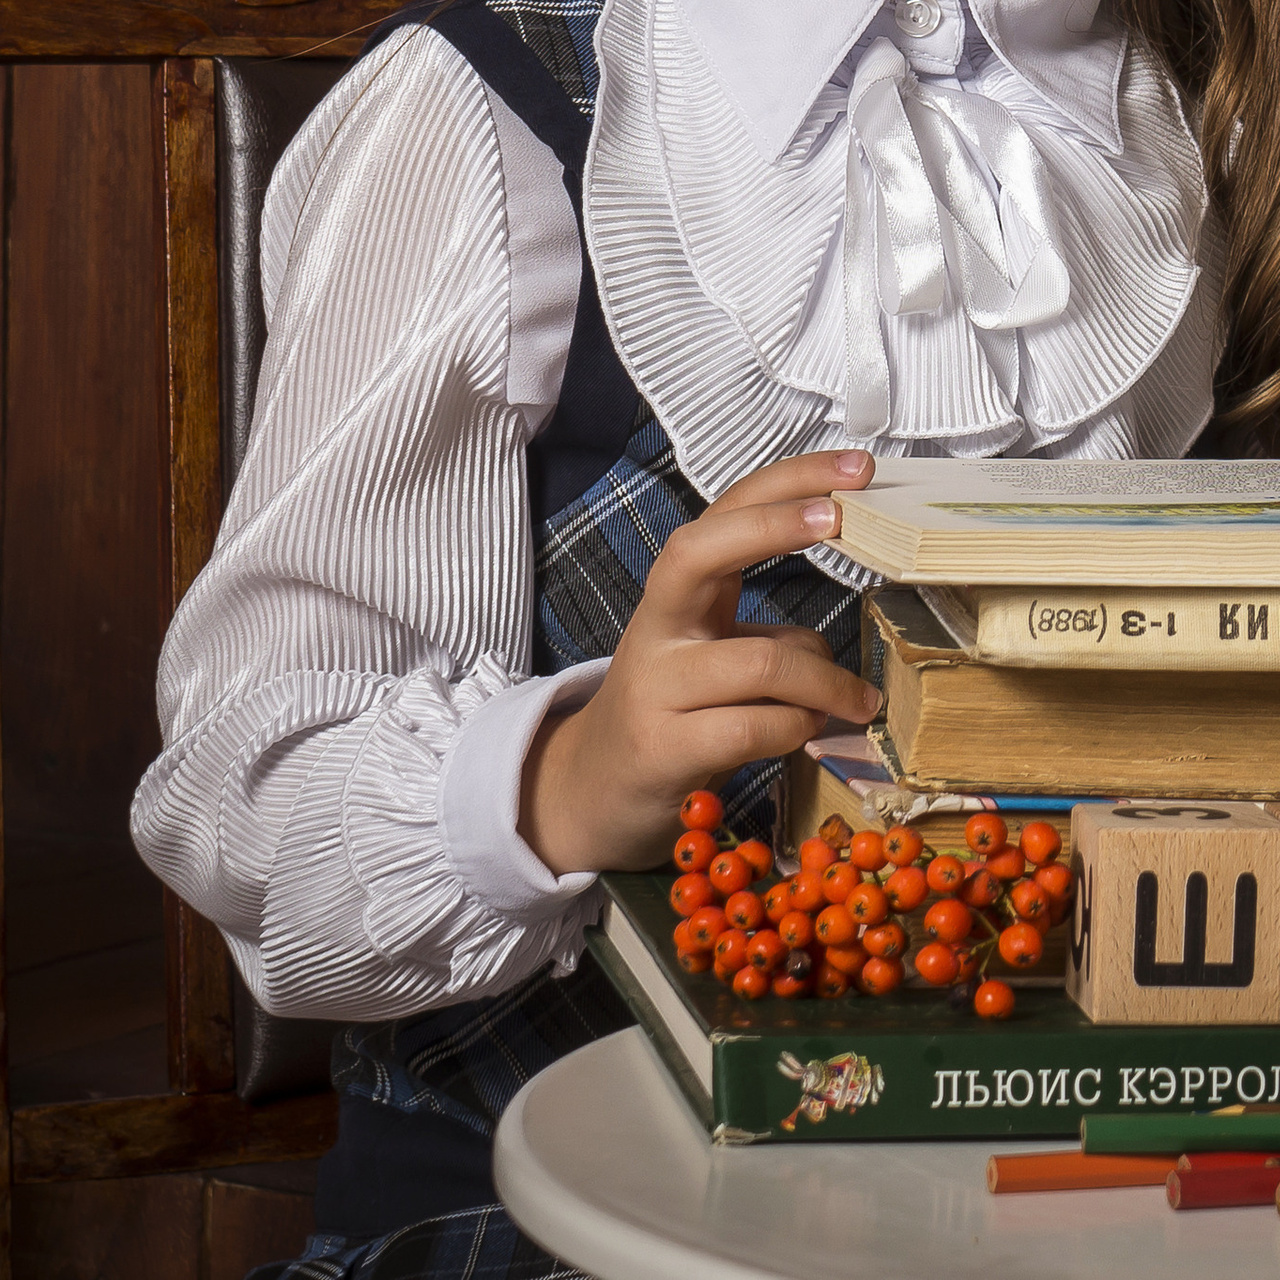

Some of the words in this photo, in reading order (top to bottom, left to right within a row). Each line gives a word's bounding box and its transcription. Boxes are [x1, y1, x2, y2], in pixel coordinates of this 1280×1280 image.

[1028, 600, 1107, 643] (1988)
[1120, 610, 1177, 637] 1-3
[931, 1067, 1101, 1108] ЛЬЮИС
